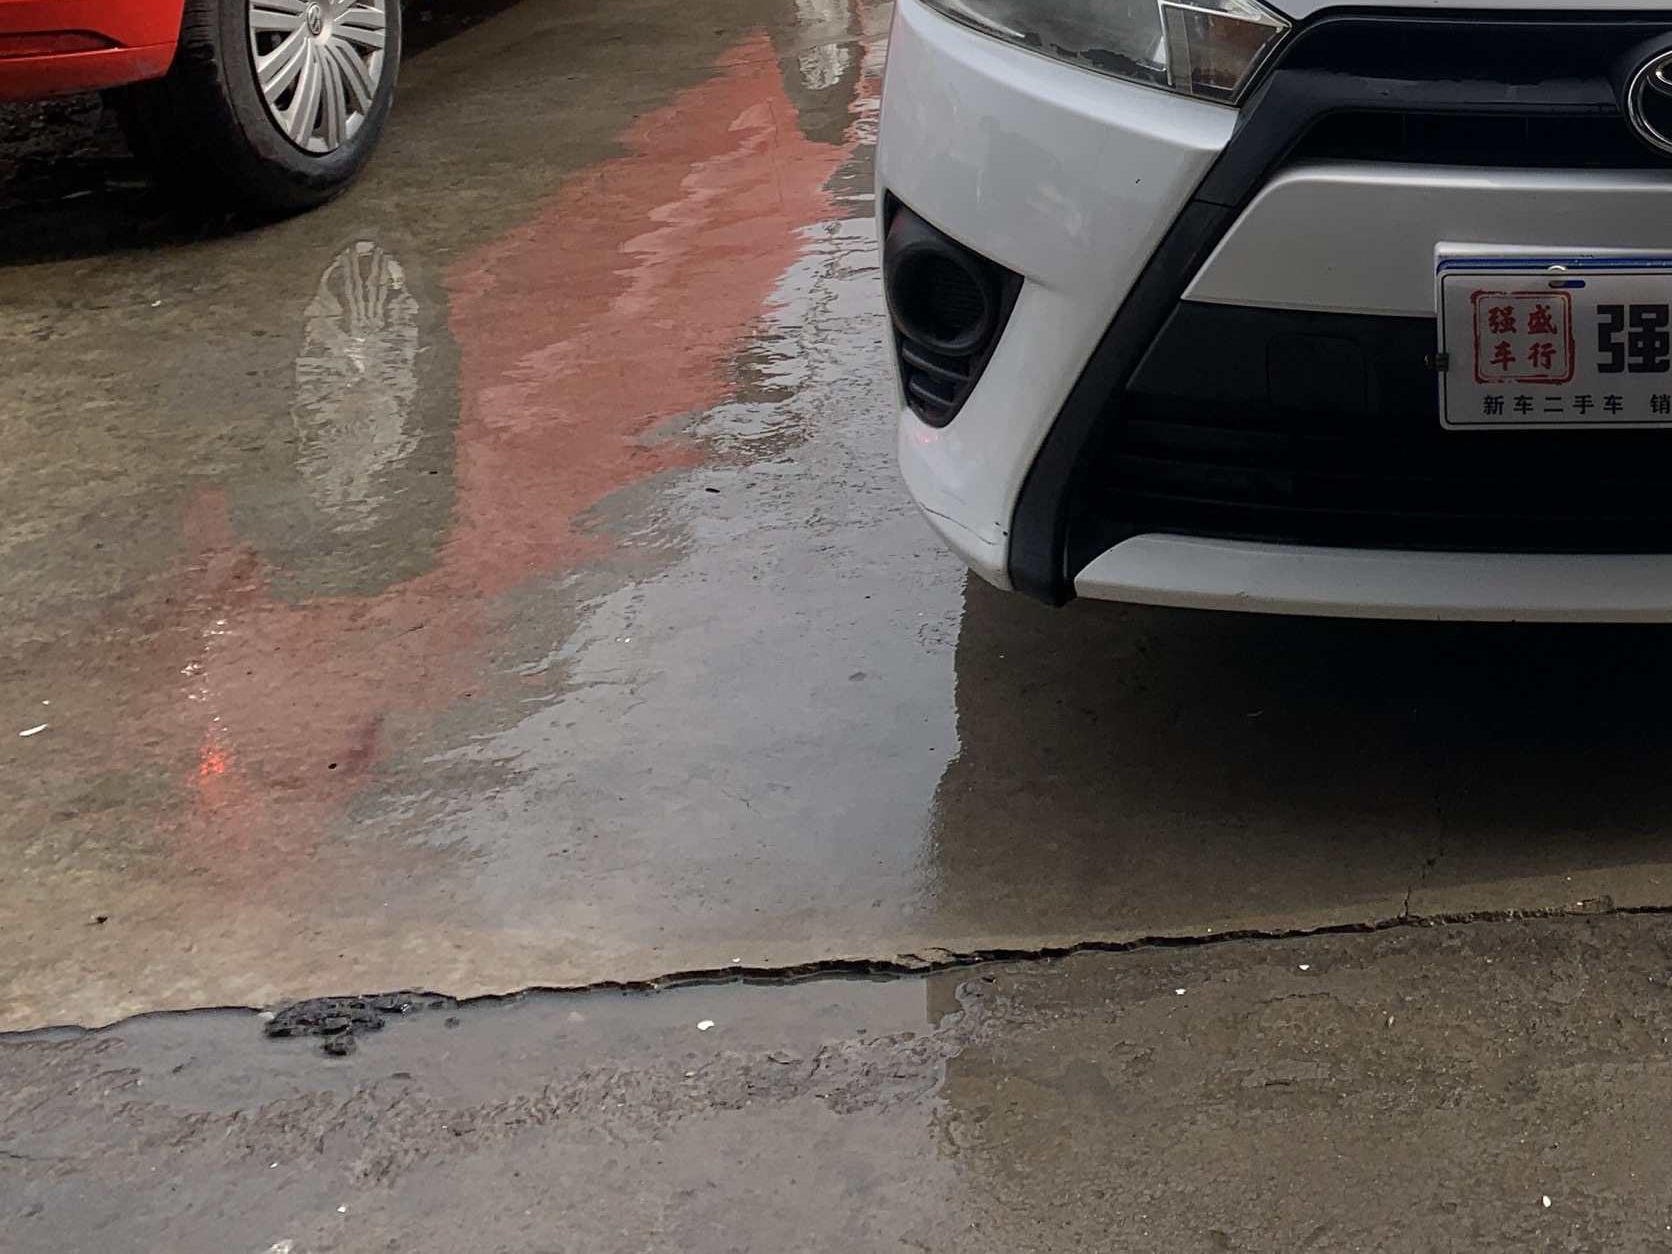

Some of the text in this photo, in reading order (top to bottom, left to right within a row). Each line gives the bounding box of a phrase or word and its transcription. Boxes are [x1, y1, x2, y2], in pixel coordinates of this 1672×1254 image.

[1487, 304, 1558, 336] 强盛
[1489, 340, 1557, 372] 车行
[1483, 394, 1625, 415] 新车二手车
